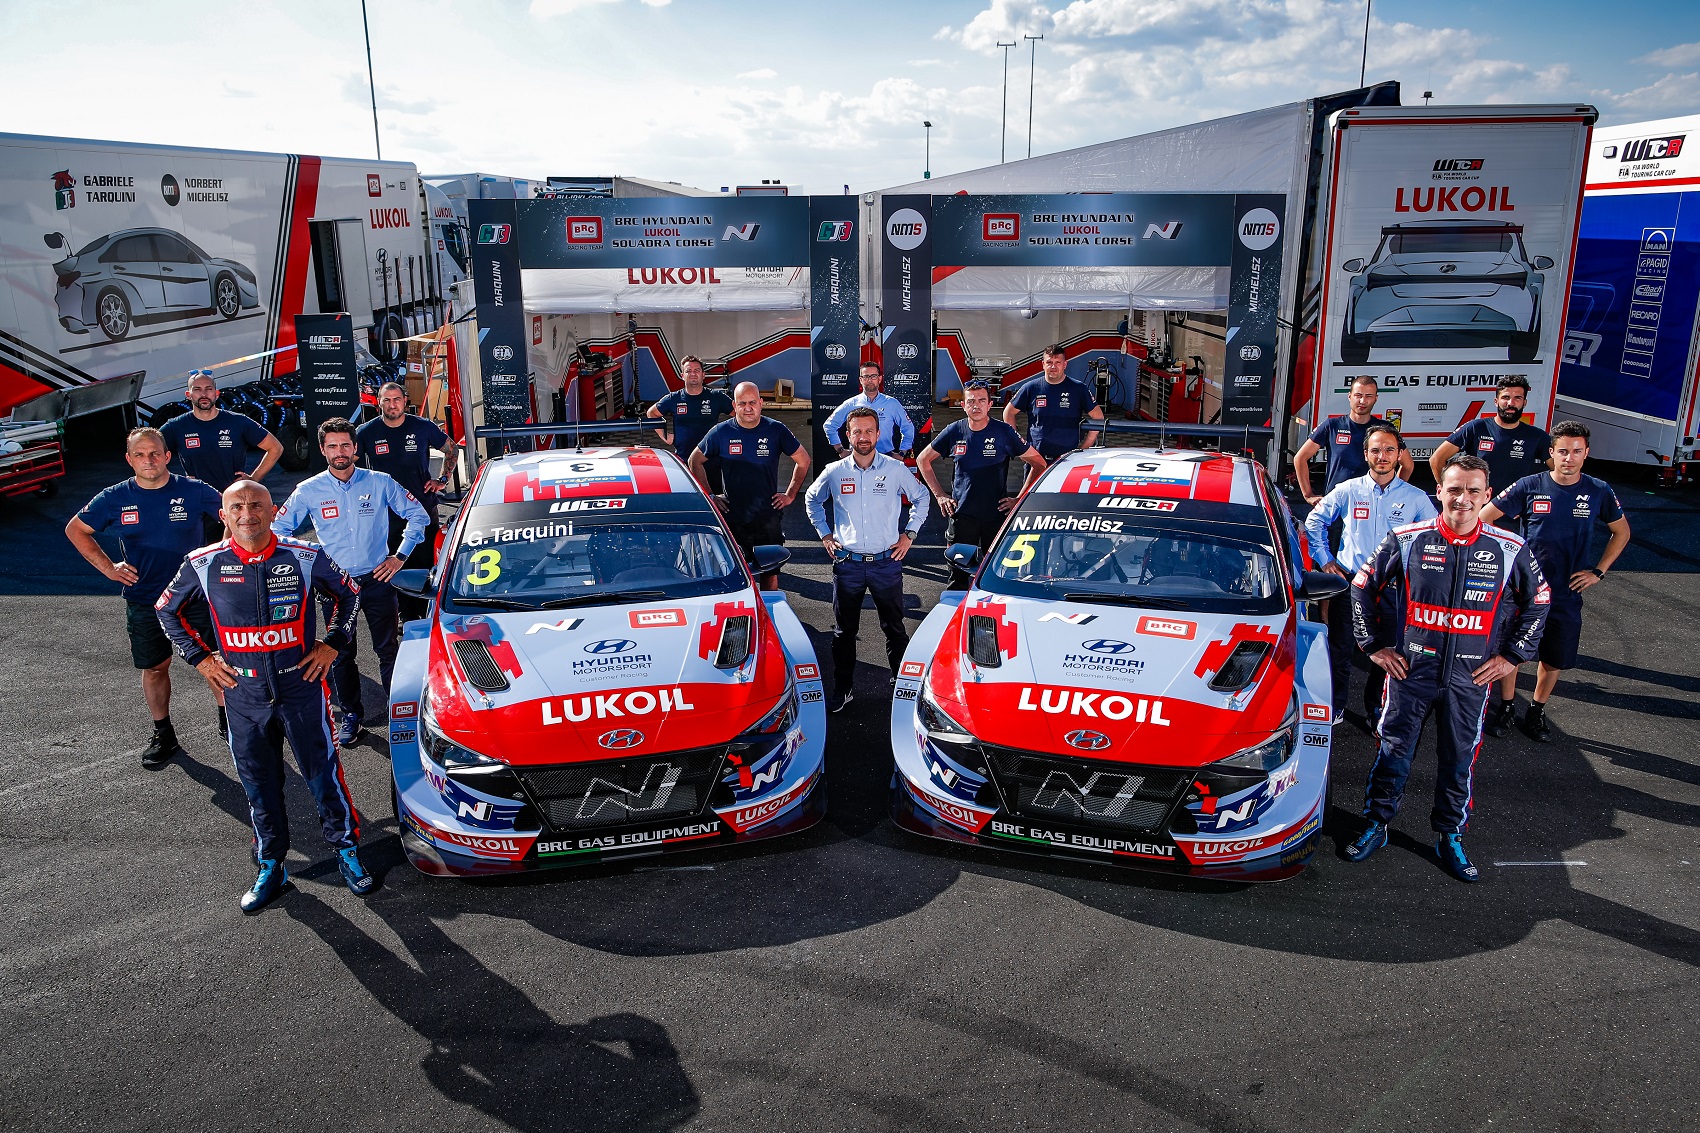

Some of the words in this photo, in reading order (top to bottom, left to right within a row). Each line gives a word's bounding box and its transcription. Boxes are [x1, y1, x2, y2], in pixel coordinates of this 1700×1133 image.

[1641, 162, 1660, 170] WORLD
[83, 175, 134, 187] GABRIELE
[184, 178, 223, 189] NORBERT
[86, 191, 136, 203] TARQUINI
[186, 192, 229, 202] MICHELISZ
[1395, 186, 1515, 213] LUKOIL
[369, 208, 411, 229] LUKOIL
[434, 206, 454, 218] LUKOIL
[1033, 214, 1059, 223] BRC
[1061, 214, 1121, 223] HYUNDAI
[1123, 214, 1134, 223] N
[614, 217, 639, 226] BRC
[642, 216, 700, 226] HYUNDAI
[702, 216, 712, 225] N
[644, 228, 681, 237] LUKOIL
[891, 223, 922, 236] NM5
[1063, 226, 1100, 235] LUKOIL
[1243, 223, 1275, 236] NM5
[612, 239, 671, 248] SQUADRA
[675, 238, 715, 247] CORSE
[1029, 237, 1090, 246] SQUADRA
[1095, 237, 1134, 245] CORSE
[1647, 257, 1667, 268] PAGID
[627, 267, 721, 285] LUKOIL
[830, 257, 839, 305] TARQUINI
[491, 260, 504, 307] TARQUINI
[902, 256, 911, 312] MICHELISZ
[1249, 257, 1261, 313] MICHELISZ
[1631, 310, 1659, 321] RECARO
[494, 347, 513, 357] FIA
[826, 347, 844, 356] FIA
[898, 346, 916, 356] FIA
[1241, 348, 1260, 358] FIA
[1384, 375, 1420, 387] GAS
[314, 386, 347, 394] GOODYEAR
[1002, 534, 1041, 568] 5
[466, 548, 502, 586] 3
[1467, 562, 1499, 570] HYUNDAI
[266, 575, 299, 584] HYUNDAI
[267, 581, 299, 589] MOTORSPORT
[1464, 589, 1494, 602] NM5
[1414, 608, 1483, 630] LUKOIL
[225, 628, 298, 649] LUKOIL
[572, 654, 652, 669] HYUNDAI
[1064, 654, 1145, 669] HYUNDAI
[573, 662, 652, 676] MOTORSPORT
[1062, 662, 1144, 676] MOTORSPORT
[579, 674, 619, 683] Customer
[620, 672, 648, 681] Racing
[1065, 671, 1105, 680] Customer
[1106, 674, 1135, 684] Racing
[801, 692, 822, 701] OMP
[895, 689, 917, 699] OMP
[541, 688, 695, 726] LUKOIL
[1017, 687, 1171, 727] LUKOIL
[391, 731, 415, 742] OMP
[1303, 735, 1329, 745] OMP
[735, 793, 791, 824] LUKOIL
[922, 791, 979, 825] LUKOIL
[403, 815, 434, 842] GOODYEAR
[1283, 818, 1319, 846] GOODYEAR
[449, 833, 519, 851] LUKOIL
[537, 840, 573, 853] BRC
[578, 836, 615, 849] GAS
[621, 821, 721, 844] EQUIPMENT
[991, 820, 1025, 837] BRC
[1030, 828, 1066, 842] GAS
[1071, 834, 1177, 856] EQUIPMENT
[1193, 838, 1264, 855] LUKOIL
